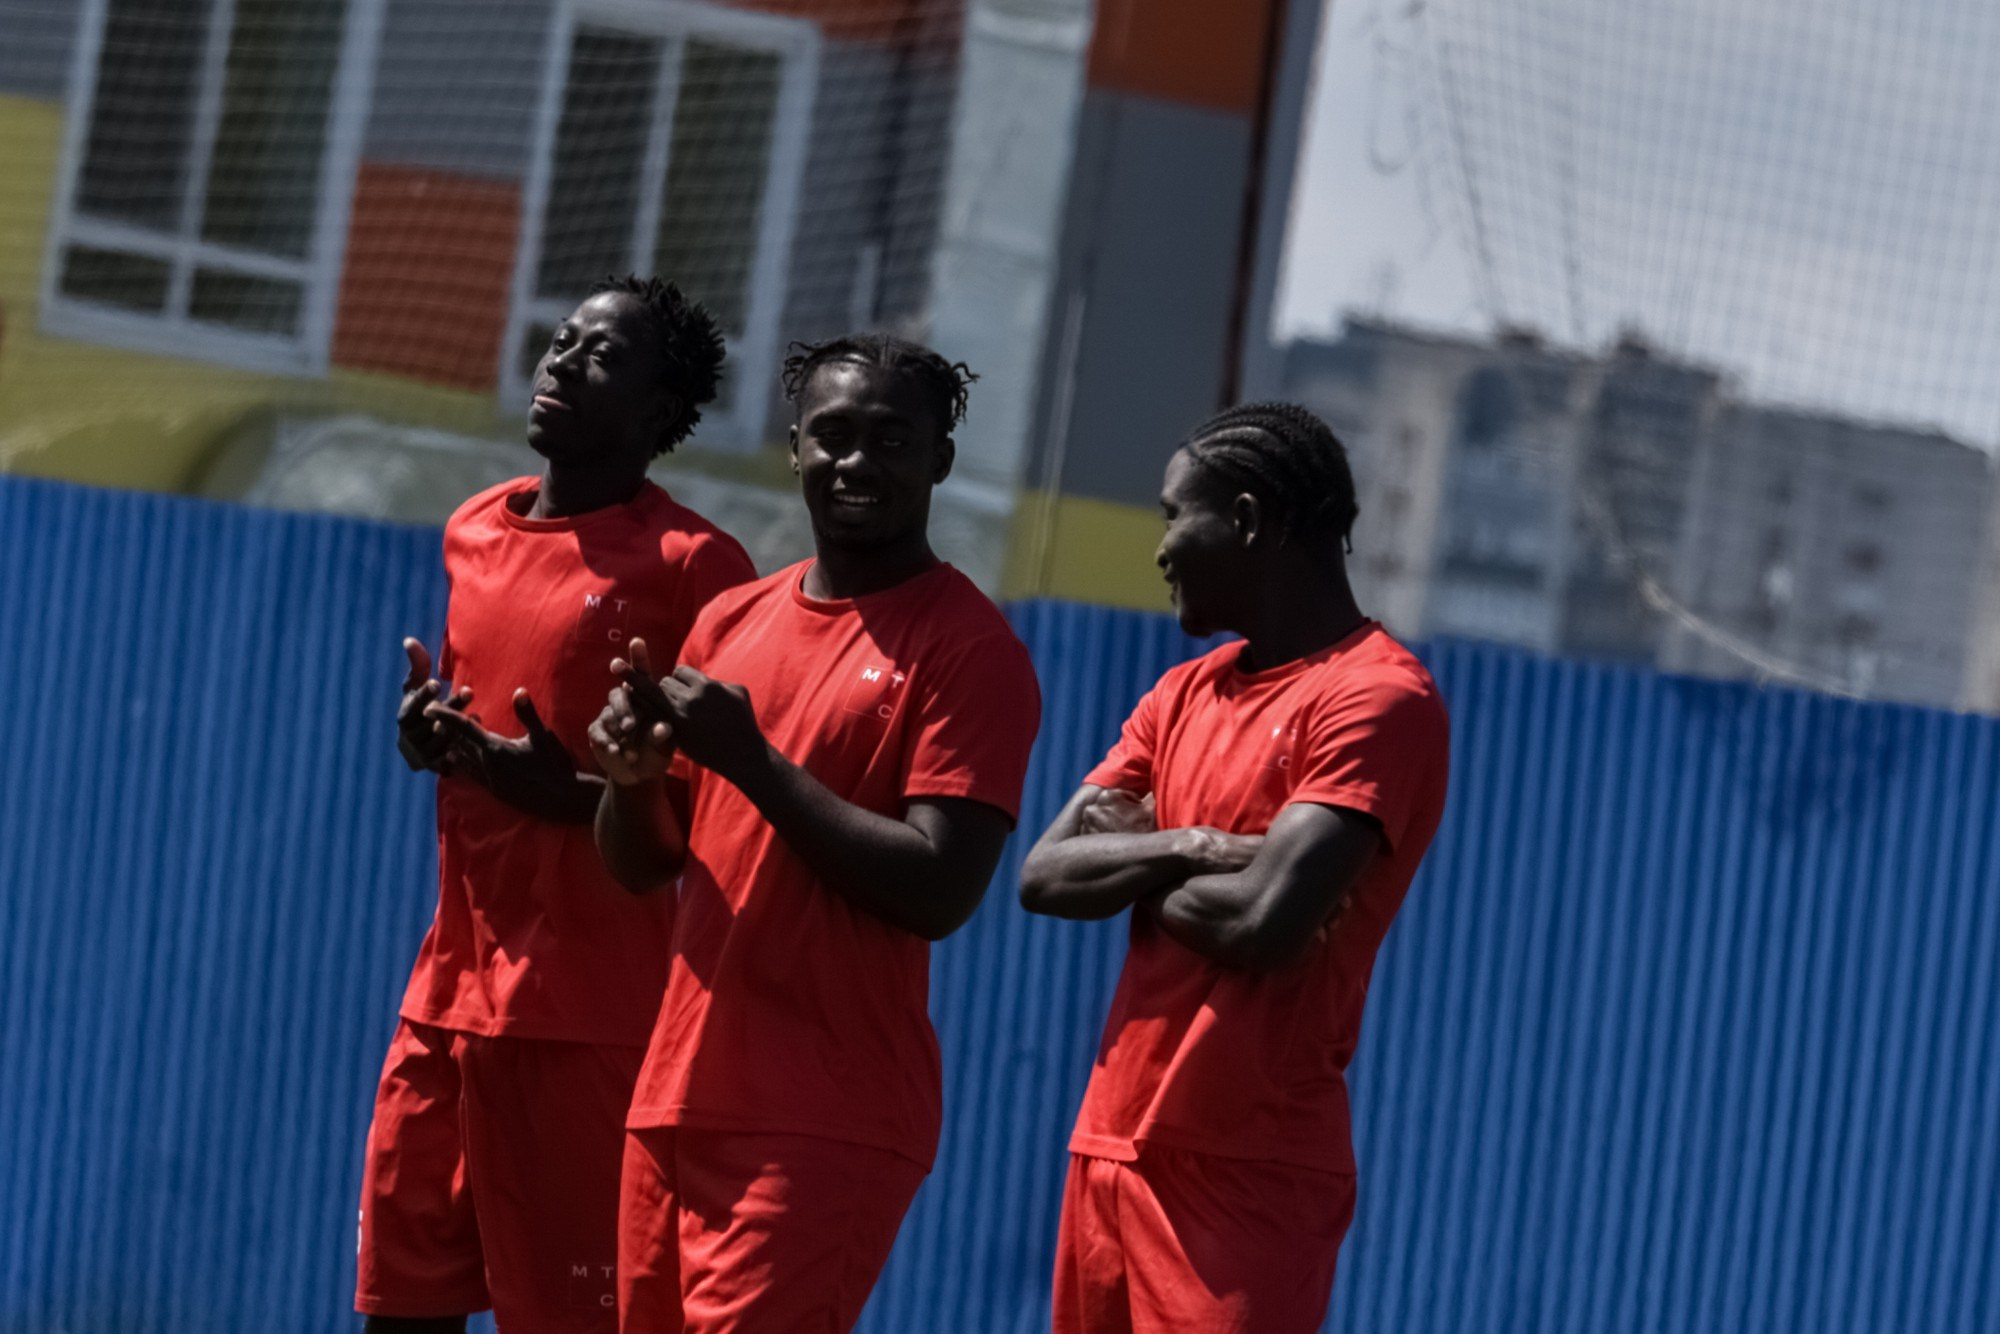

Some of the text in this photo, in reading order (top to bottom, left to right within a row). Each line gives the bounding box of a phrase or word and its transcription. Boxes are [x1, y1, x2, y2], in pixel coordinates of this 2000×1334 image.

[585, 594, 627, 612] M T
[608, 628, 621, 642] C
[862, 668, 905, 688] M T
[878, 704, 893, 719] C
[572, 1265, 614, 1279] M T
[600, 1294, 614, 1307] C
